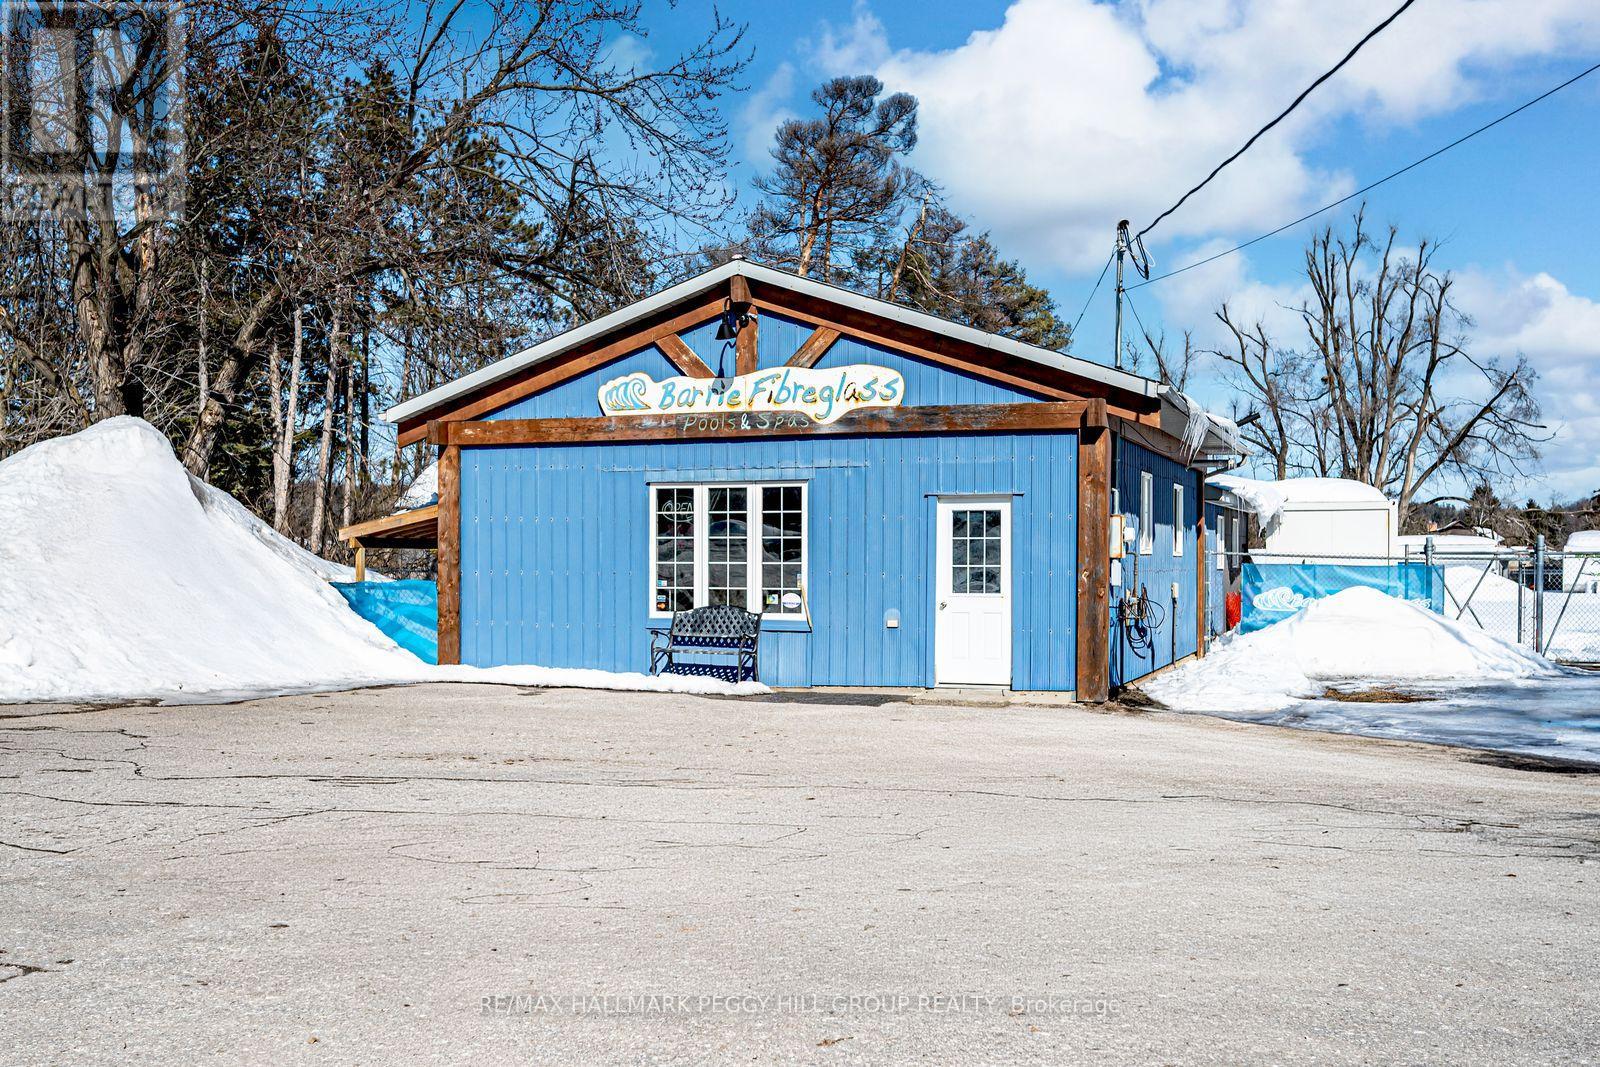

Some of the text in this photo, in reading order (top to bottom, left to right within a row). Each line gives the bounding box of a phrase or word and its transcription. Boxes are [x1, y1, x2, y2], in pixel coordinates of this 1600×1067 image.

[658, 369, 900, 418] Barrie Fibreglass
[683, 412, 809, 431] Pools & Spas
